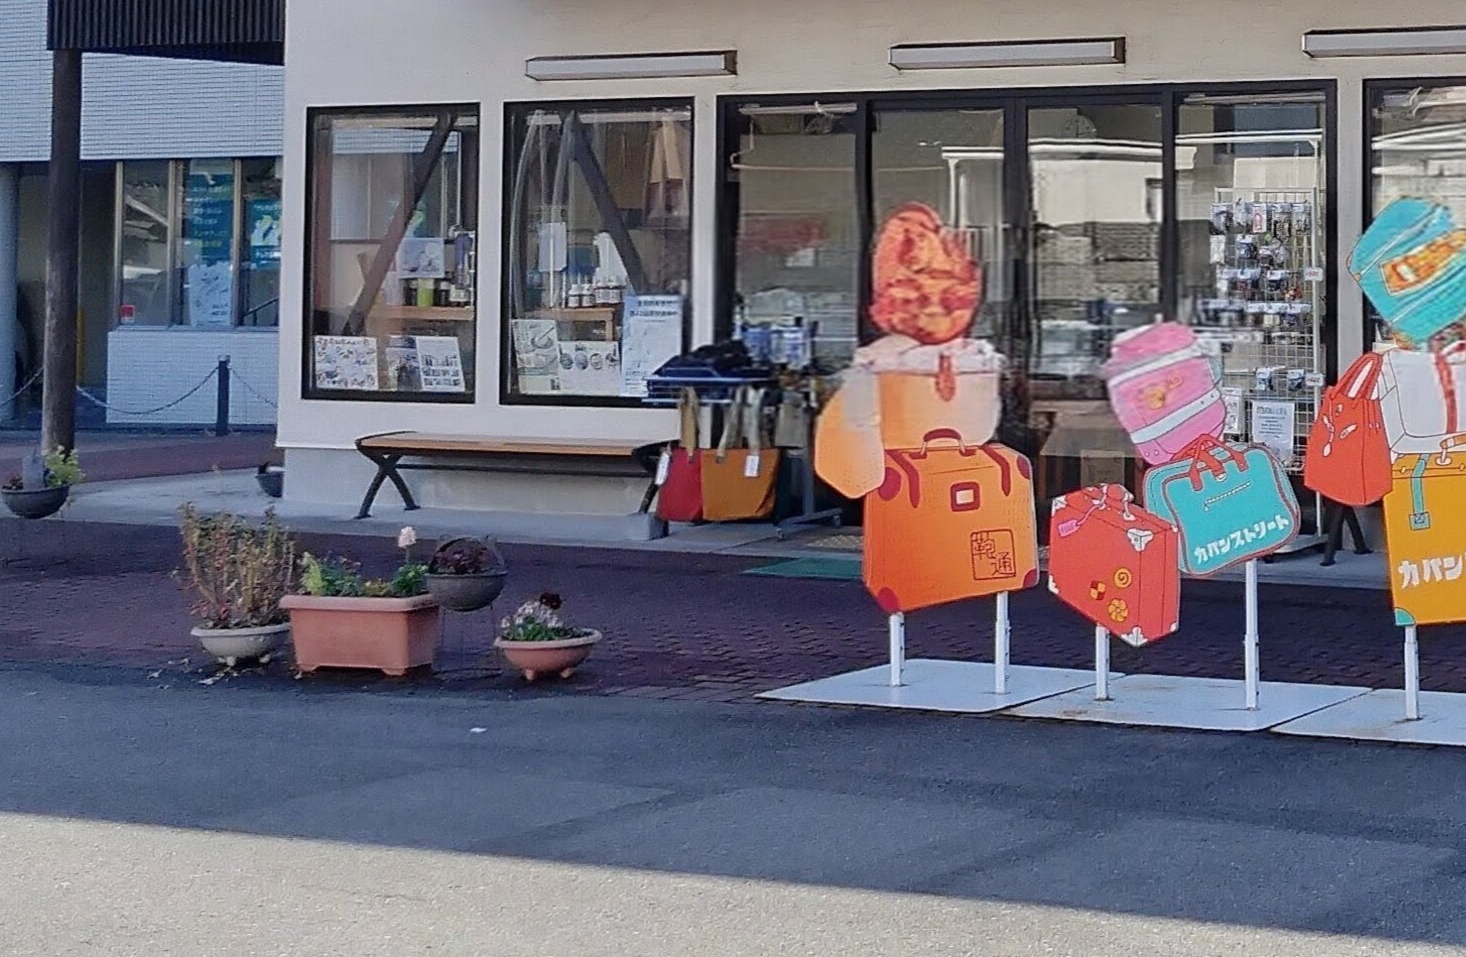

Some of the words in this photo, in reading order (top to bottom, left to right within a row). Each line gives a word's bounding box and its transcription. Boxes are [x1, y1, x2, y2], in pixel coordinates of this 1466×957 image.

[1194, 514, 1290, 564] カバンストリート
